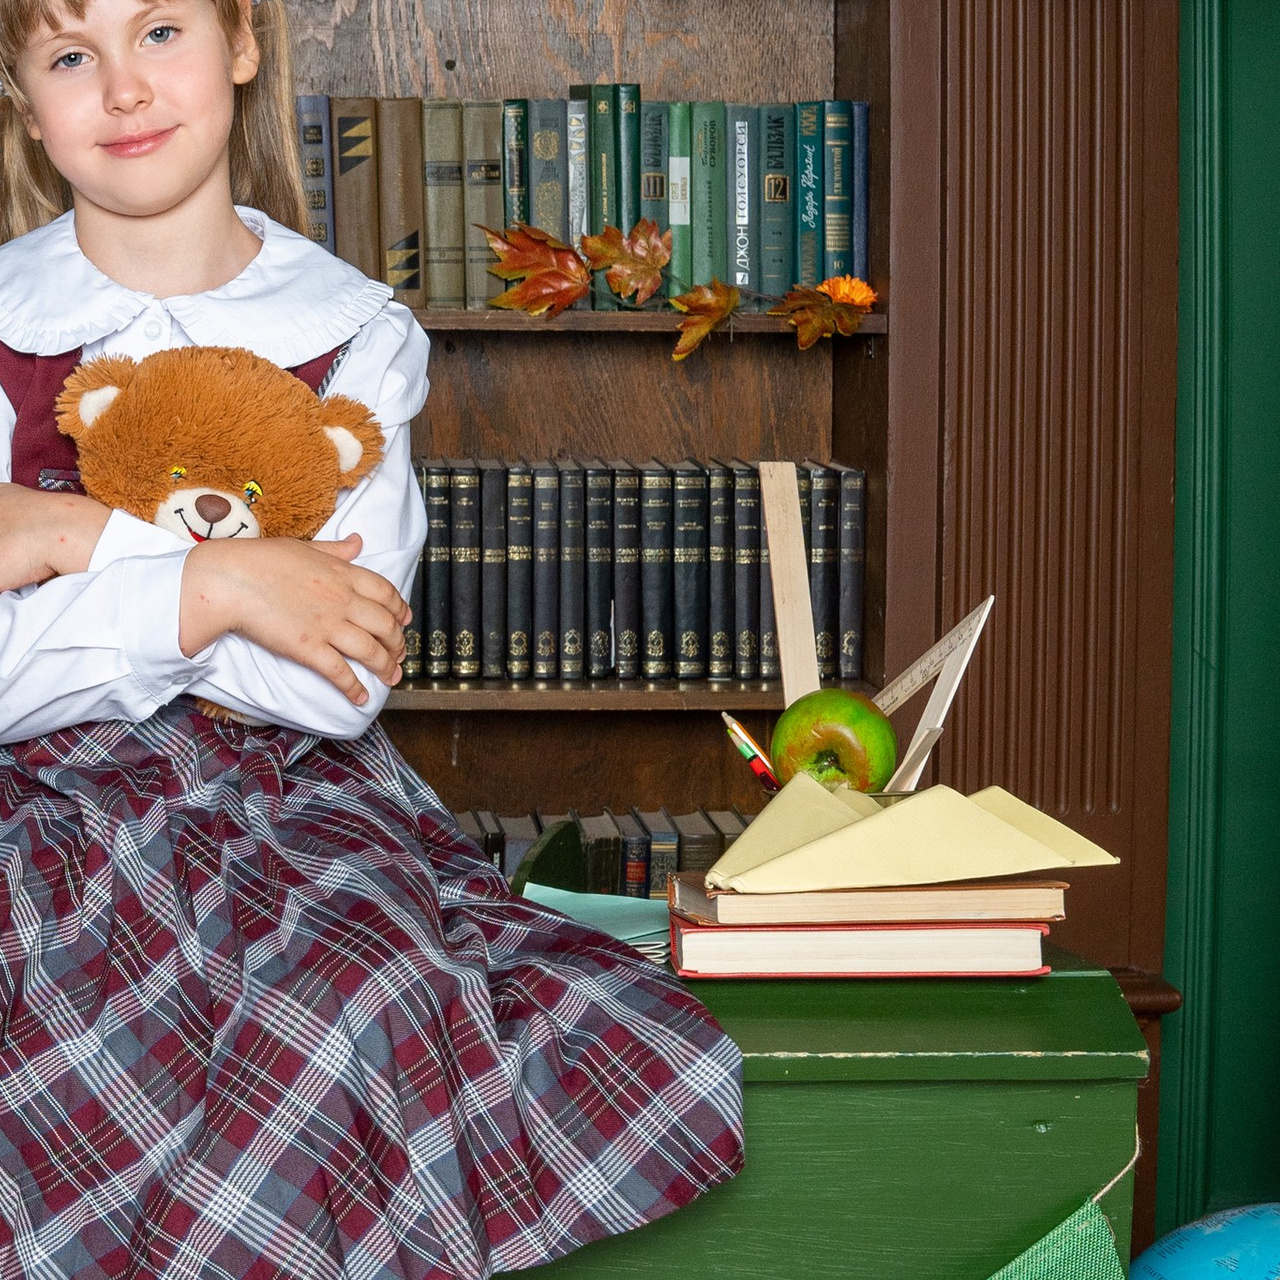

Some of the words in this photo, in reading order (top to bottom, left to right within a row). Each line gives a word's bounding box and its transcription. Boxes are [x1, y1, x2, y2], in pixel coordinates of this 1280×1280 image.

[708, 118, 717, 167] СУВОРОВ
[766, 114, 785, 171] БАЛЬЗАК
[735, 121, 748, 222] ГОЛСУОРСИ
[767, 178, 784, 196] 12
[735, 225, 750, 270] ДЖОН
[832, 259, 843, 270] 10
